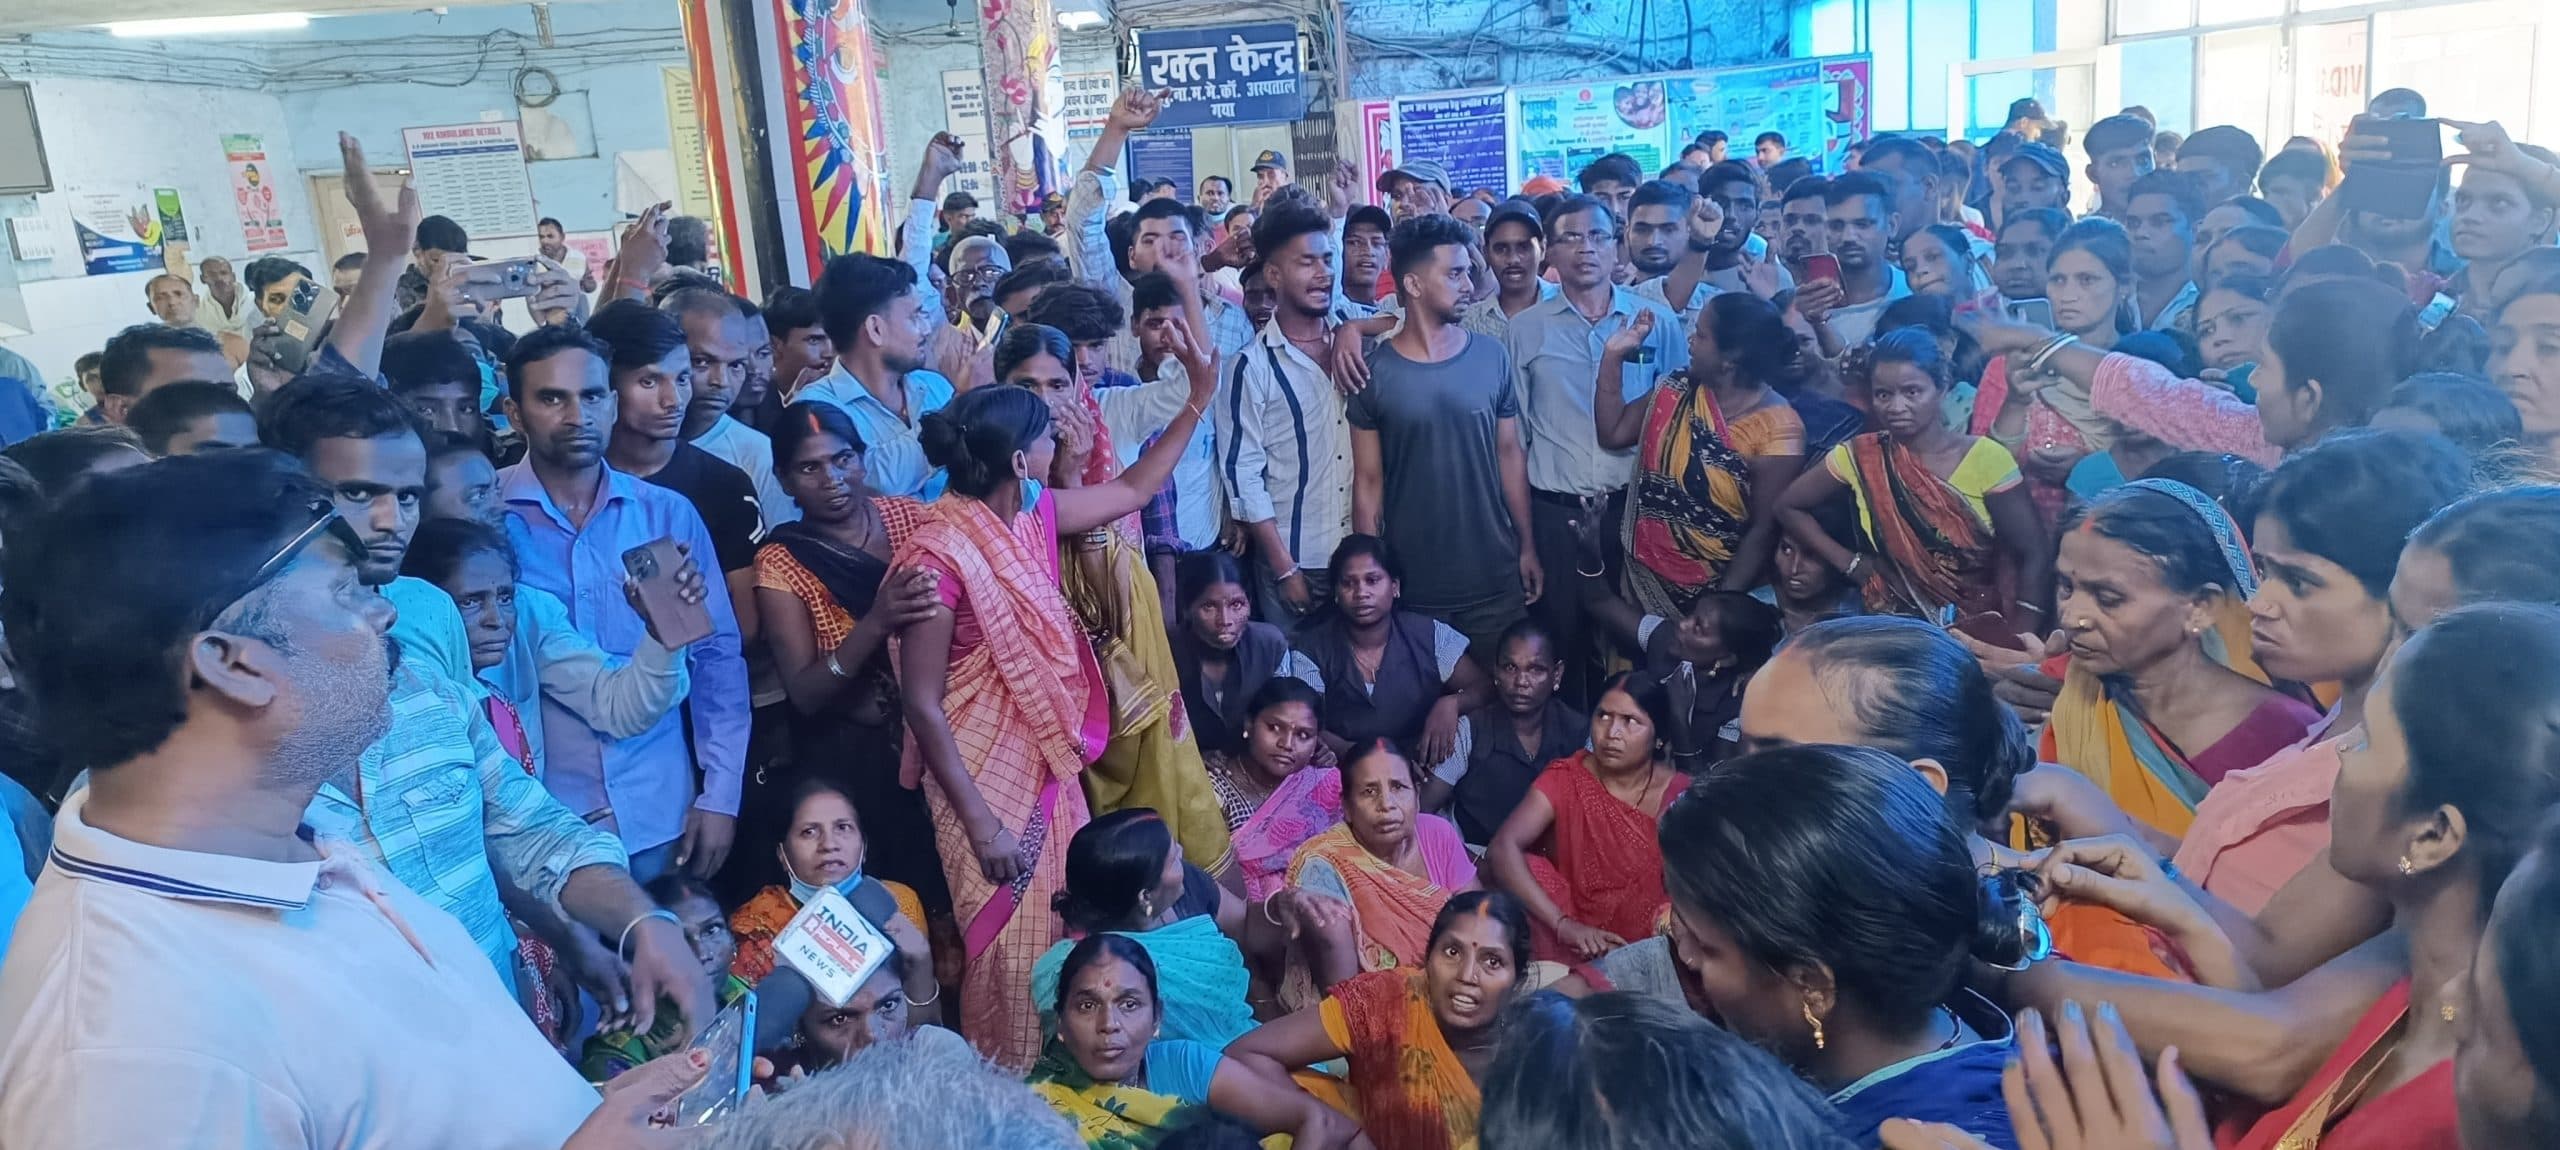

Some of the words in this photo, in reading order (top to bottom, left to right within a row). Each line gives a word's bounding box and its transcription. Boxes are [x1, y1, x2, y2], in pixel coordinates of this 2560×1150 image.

[1147, 47, 1218, 85] रक्त
[1225, 35, 1295, 76] केन्द्र
[1246, 79, 1296, 97] अस्पताल
[1211, 102, 1236, 118] गया
[816, 905, 869, 957] INDIA
[799, 944, 836, 979] NEWS
